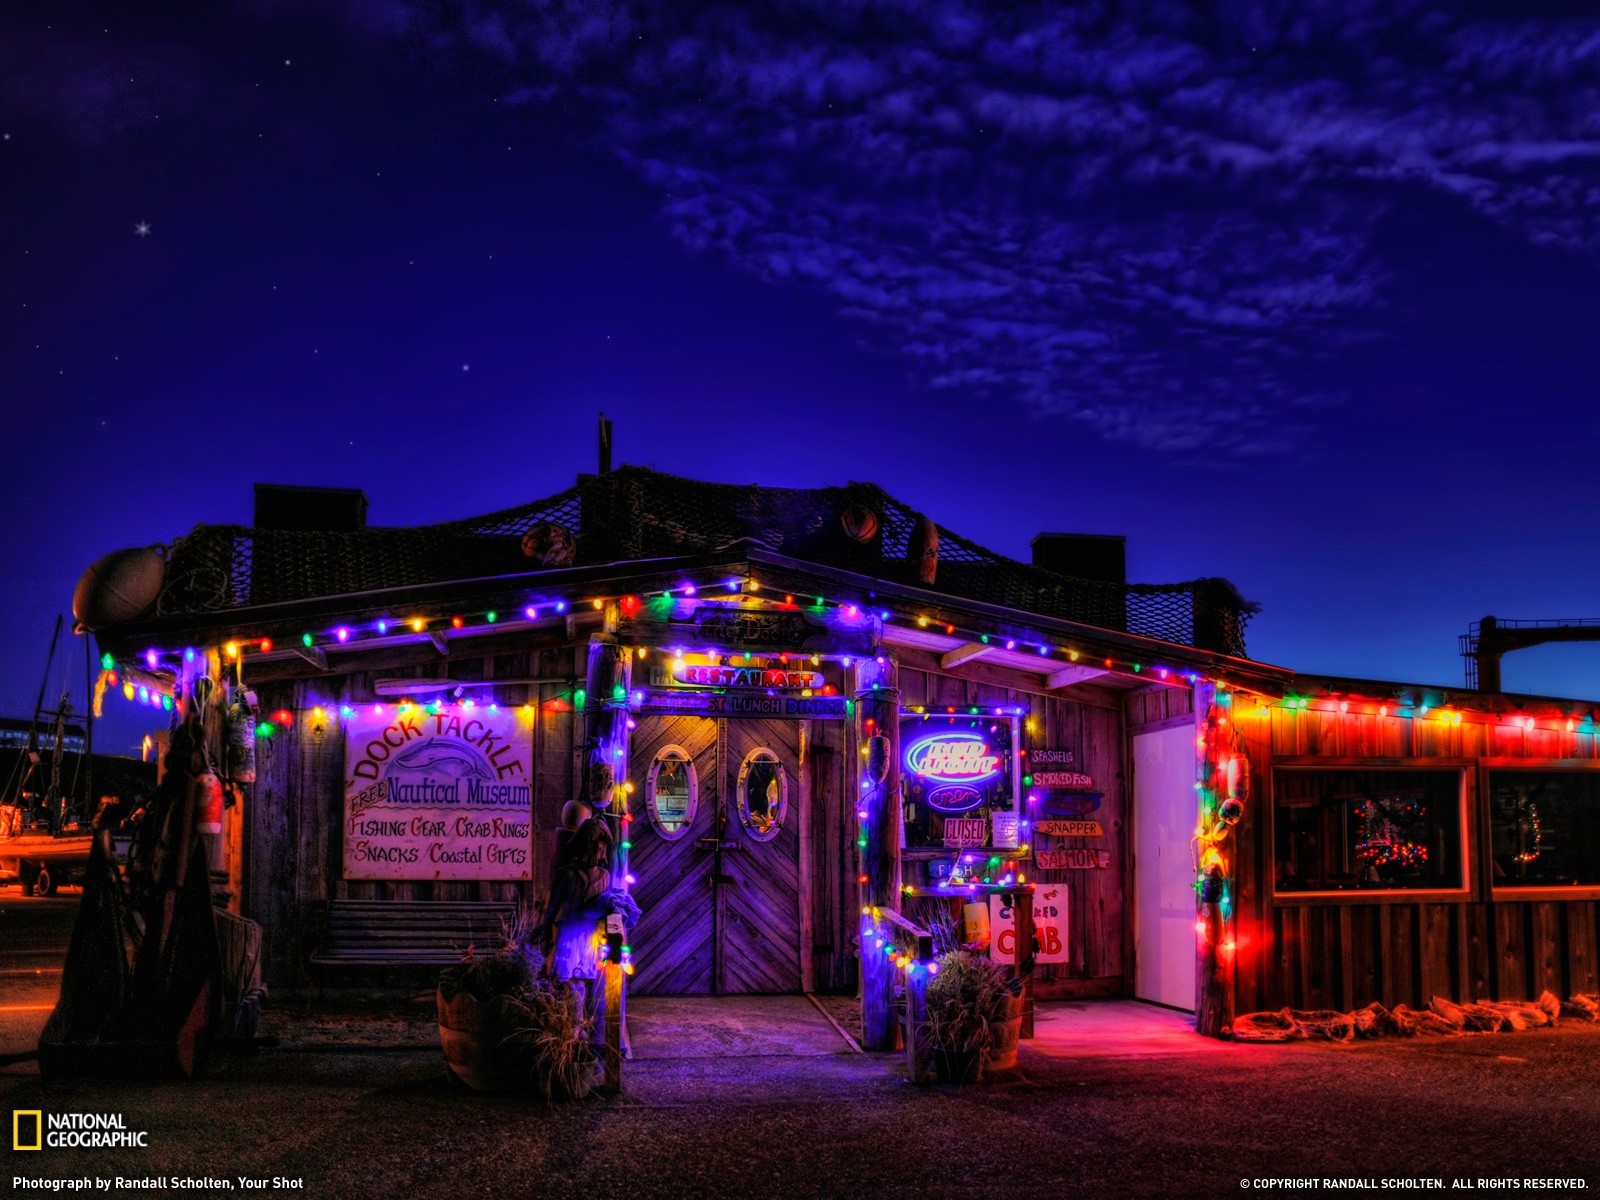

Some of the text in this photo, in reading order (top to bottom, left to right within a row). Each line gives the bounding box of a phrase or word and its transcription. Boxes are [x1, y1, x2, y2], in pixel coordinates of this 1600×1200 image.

[685, 668, 814, 688] RESTAURANT
[732, 697, 782, 714] LUNCH
[785, 699, 847, 715] DINNER
[353, 713, 523, 780] DOCK TACKLE
[1033, 772, 1072, 785] SMOKED
[351, 781, 385, 812] FREE
[386, 777, 531, 806] Nautical Museum
[350, 813, 529, 838] FISHING GEAR CRAB RINGS
[945, 819, 984, 840] CLOSED
[1046, 822, 1097, 834] SNAPPER
[354, 840, 419, 862] SNACKS
[999, 906, 1058, 919] CKED
[997, 926, 1062, 955] CB
